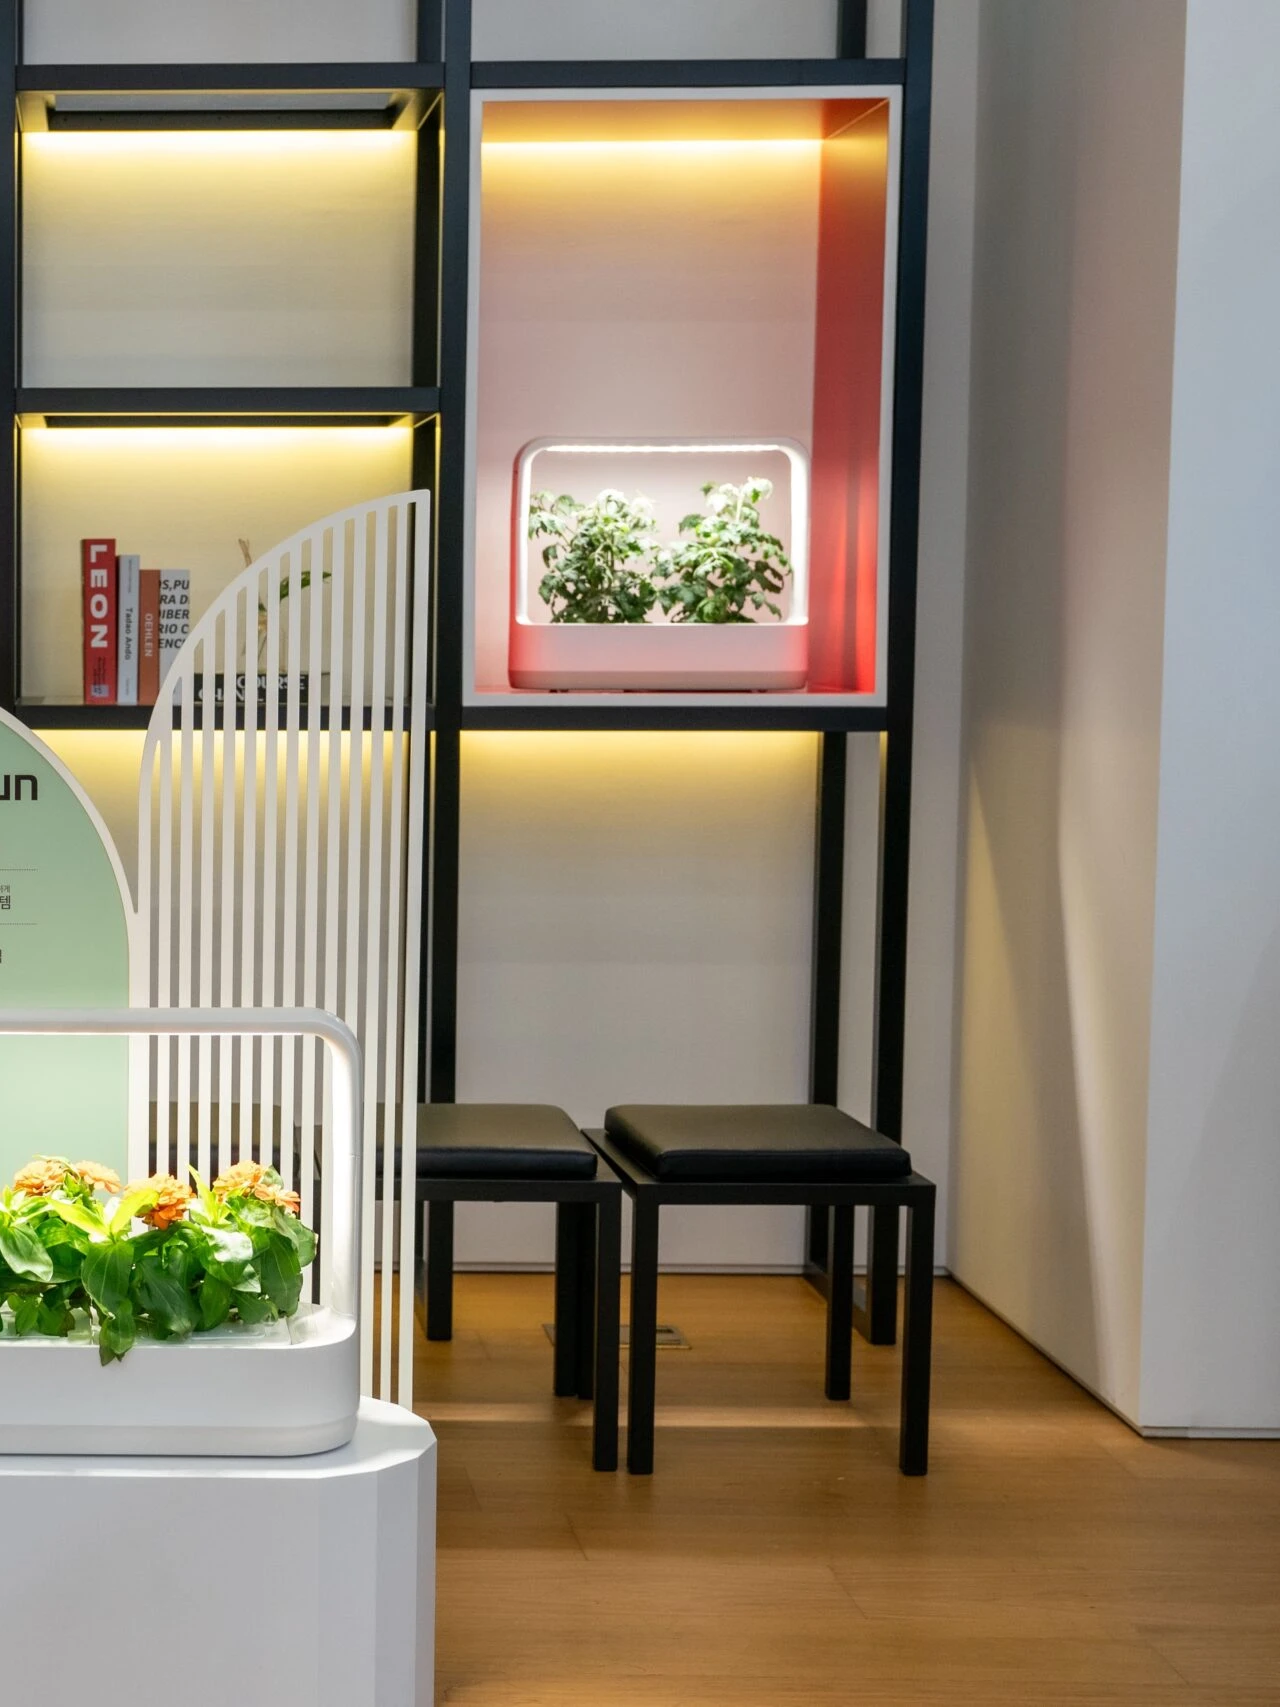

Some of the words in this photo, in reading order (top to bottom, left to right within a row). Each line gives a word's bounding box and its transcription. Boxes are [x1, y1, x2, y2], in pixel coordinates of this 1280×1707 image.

[90, 544, 109, 649] LEON
[125, 608, 134, 634] Tadao
[159, 609, 190, 620] IBER
[125, 636, 134, 661] Ando
